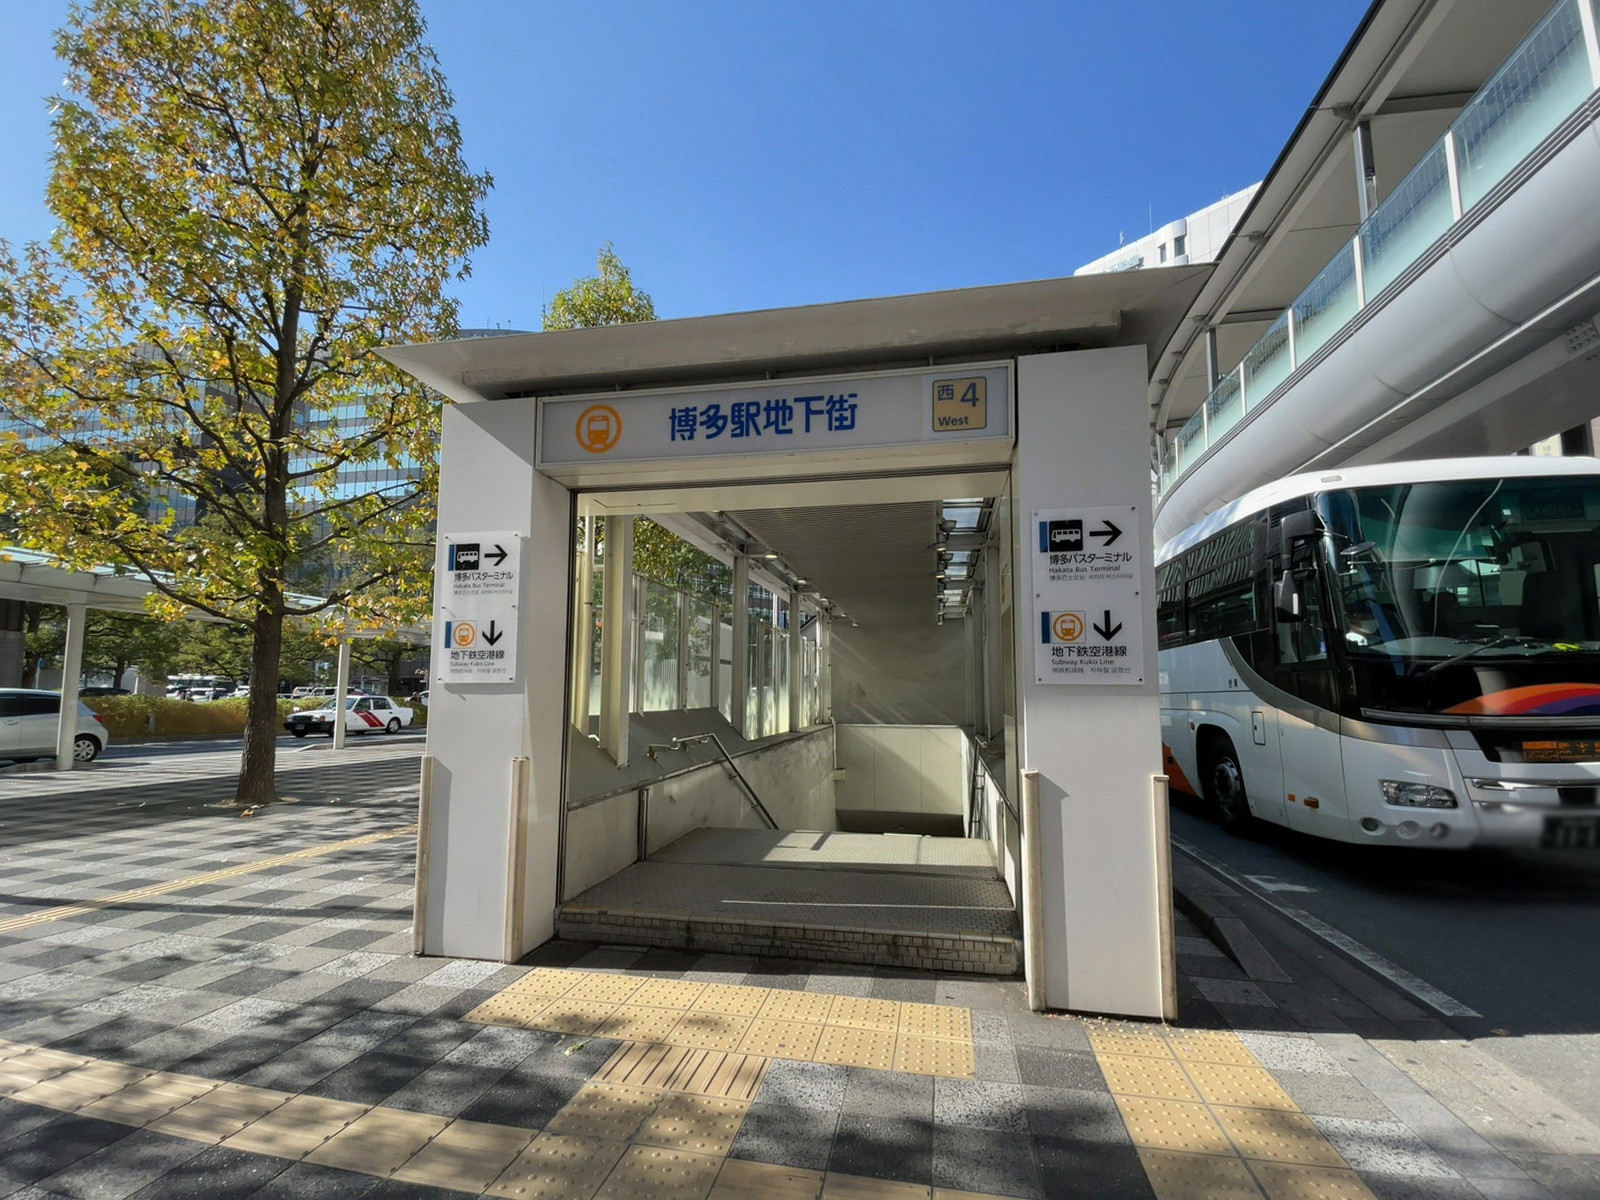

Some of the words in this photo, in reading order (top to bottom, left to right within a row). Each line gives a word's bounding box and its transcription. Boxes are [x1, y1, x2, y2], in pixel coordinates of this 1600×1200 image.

[937, 384, 954, 401] 西
[960, 382, 979, 407] 4
[668, 392, 858, 441] 博多駅地下街
[938, 416, 969, 427] West
[1049, 552, 1132, 565] 博多バスターミナル
[454, 571, 514, 582] 博多バスターミナル
[450, 650, 505, 660] 地下鉄空港線
[1051, 646, 1127, 657] 地下鉄空港線
[1051, 658, 1078, 666] Subway
